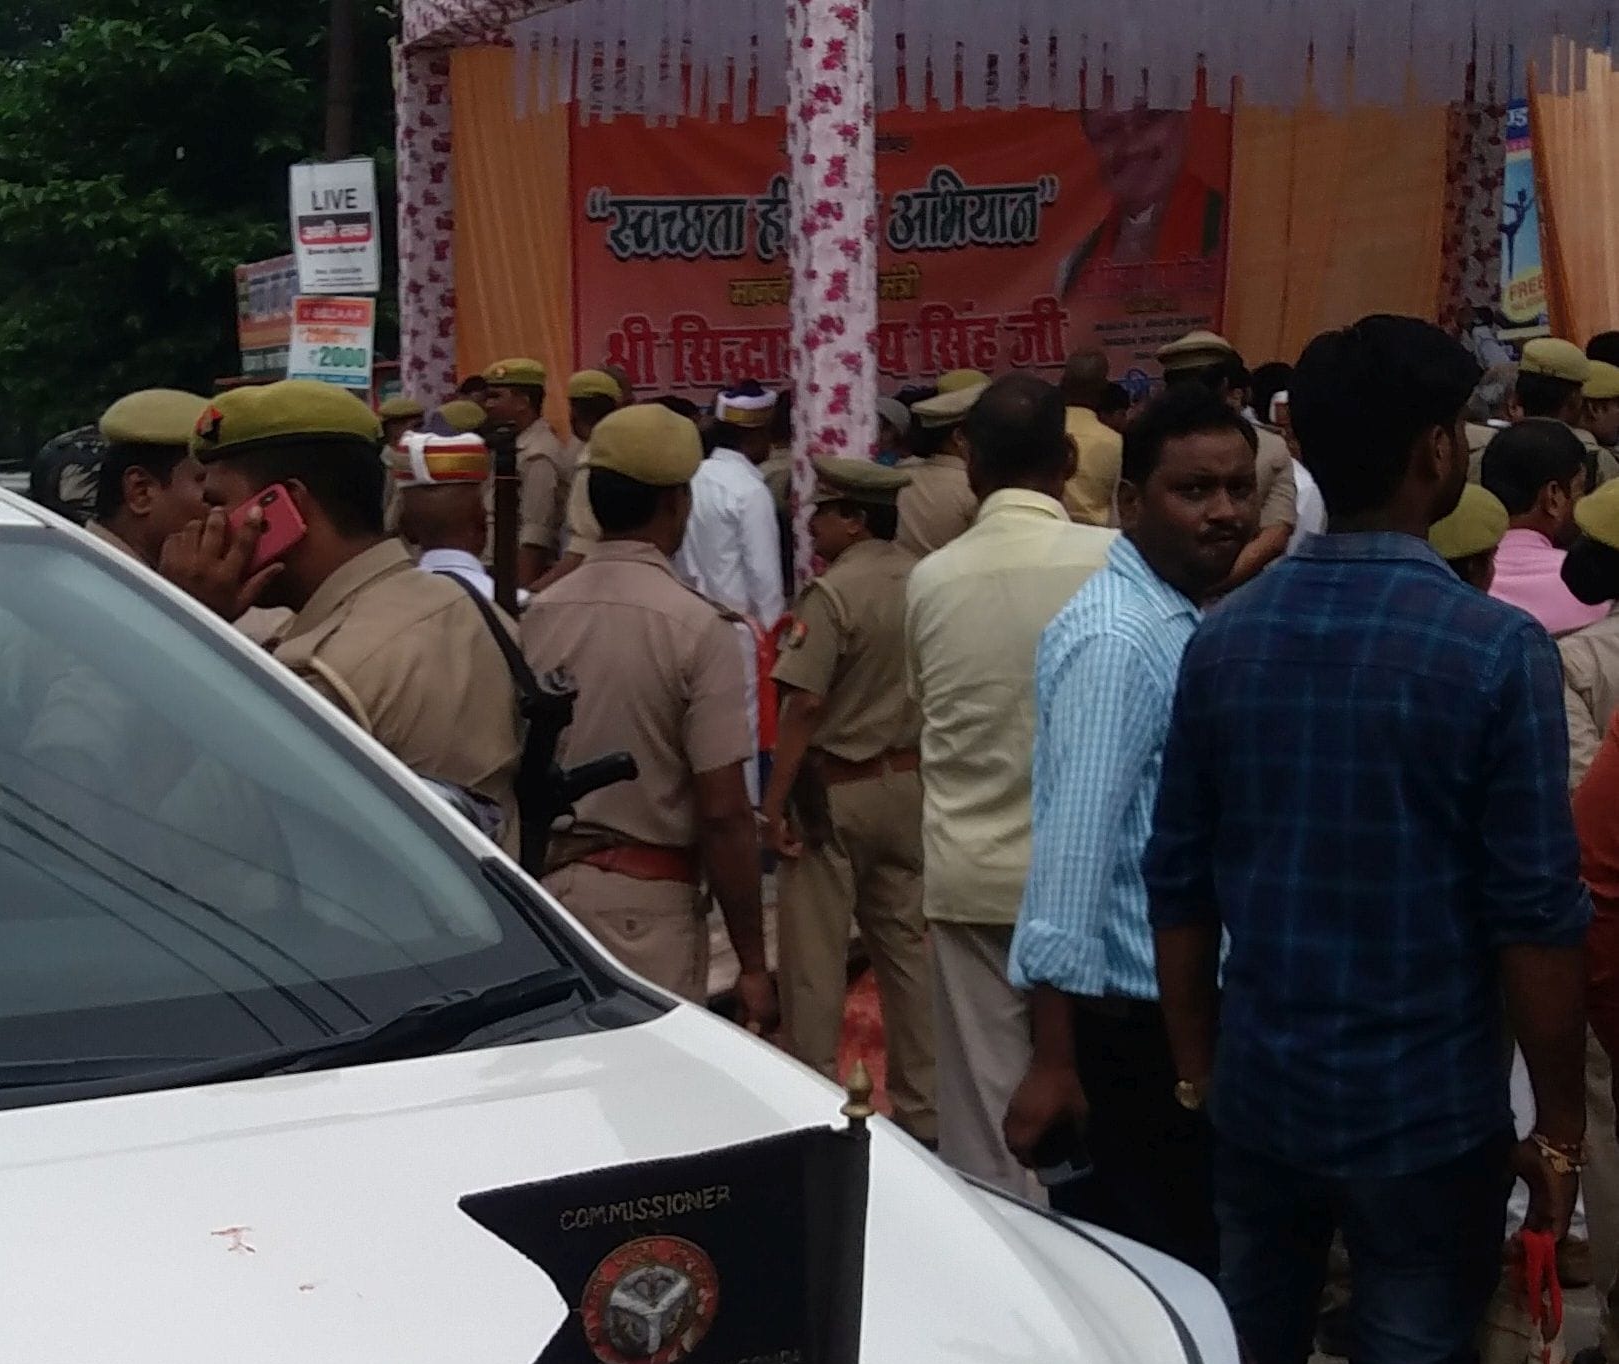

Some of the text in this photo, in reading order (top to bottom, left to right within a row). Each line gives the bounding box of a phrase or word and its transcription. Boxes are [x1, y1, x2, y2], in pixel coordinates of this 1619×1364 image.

[311, 187, 359, 211] LIVE
[1004, 296, 1070, 367] जी
[559, 1184, 731, 1231] COMMISSIONER
